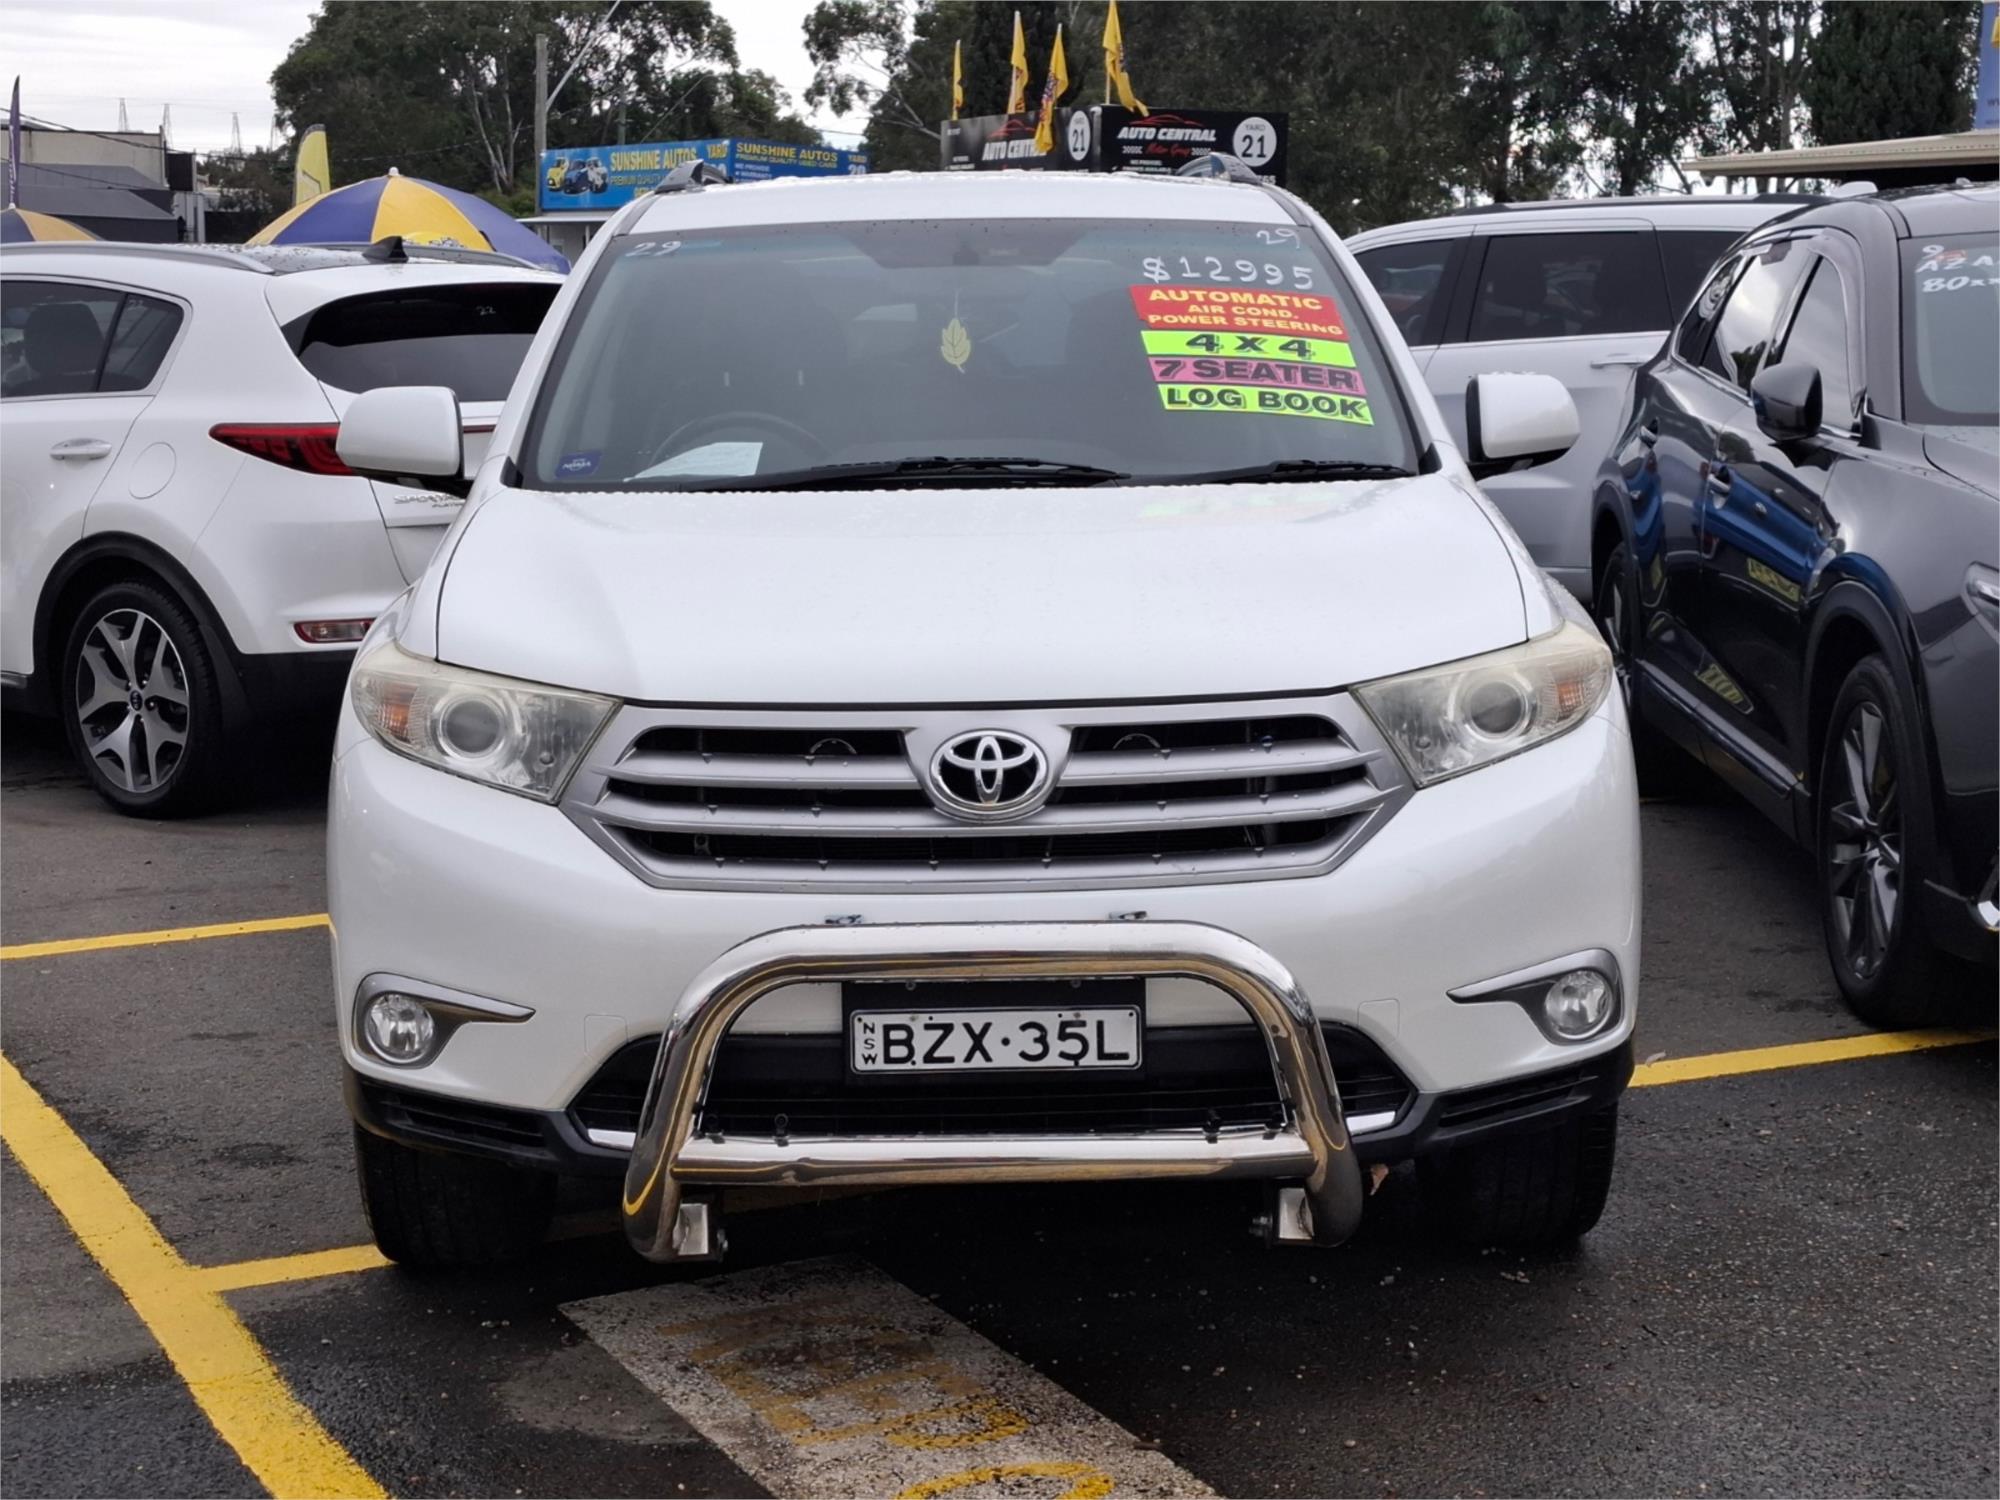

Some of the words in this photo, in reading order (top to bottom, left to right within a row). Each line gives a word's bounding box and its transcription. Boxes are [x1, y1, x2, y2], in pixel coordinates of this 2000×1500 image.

[1072, 128, 1086, 152] 21
[1117, 127, 1155, 140] AUTO
[1157, 128, 1217, 142] CENTRAL
[1241, 134, 1267, 158] 21
[611, 150, 660, 171] SUNSHINE
[663, 147, 698, 169] AUTOS
[736, 142, 797, 158] SUNSHINE
[800, 149, 838, 162] AUTOS
[982, 141, 1007, 161] AUTO
[1008, 139, 1047, 159] CENTR
[625, 240, 682, 258] 29
[1256, 228, 1300, 249] 29
[1143, 256, 1313, 290] $12995
[1149, 289, 1323, 310] AUTOMATIC
[1187, 303, 1226, 315] AIR
[1231, 306, 1300, 319] COND.
[1148, 314, 1229, 326] POWER
[1234, 316, 1344, 336] STEERING
[1186, 333, 1224, 354] 4
[1278, 339, 1317, 360] 4
[1154, 359, 1187, 380] 7
[1193, 359, 1359, 393] SEATER
[1166, 387, 1247, 409] LOG
[1257, 390, 1369, 421] BOOK
[862, 1022, 878, 1065] NSW
